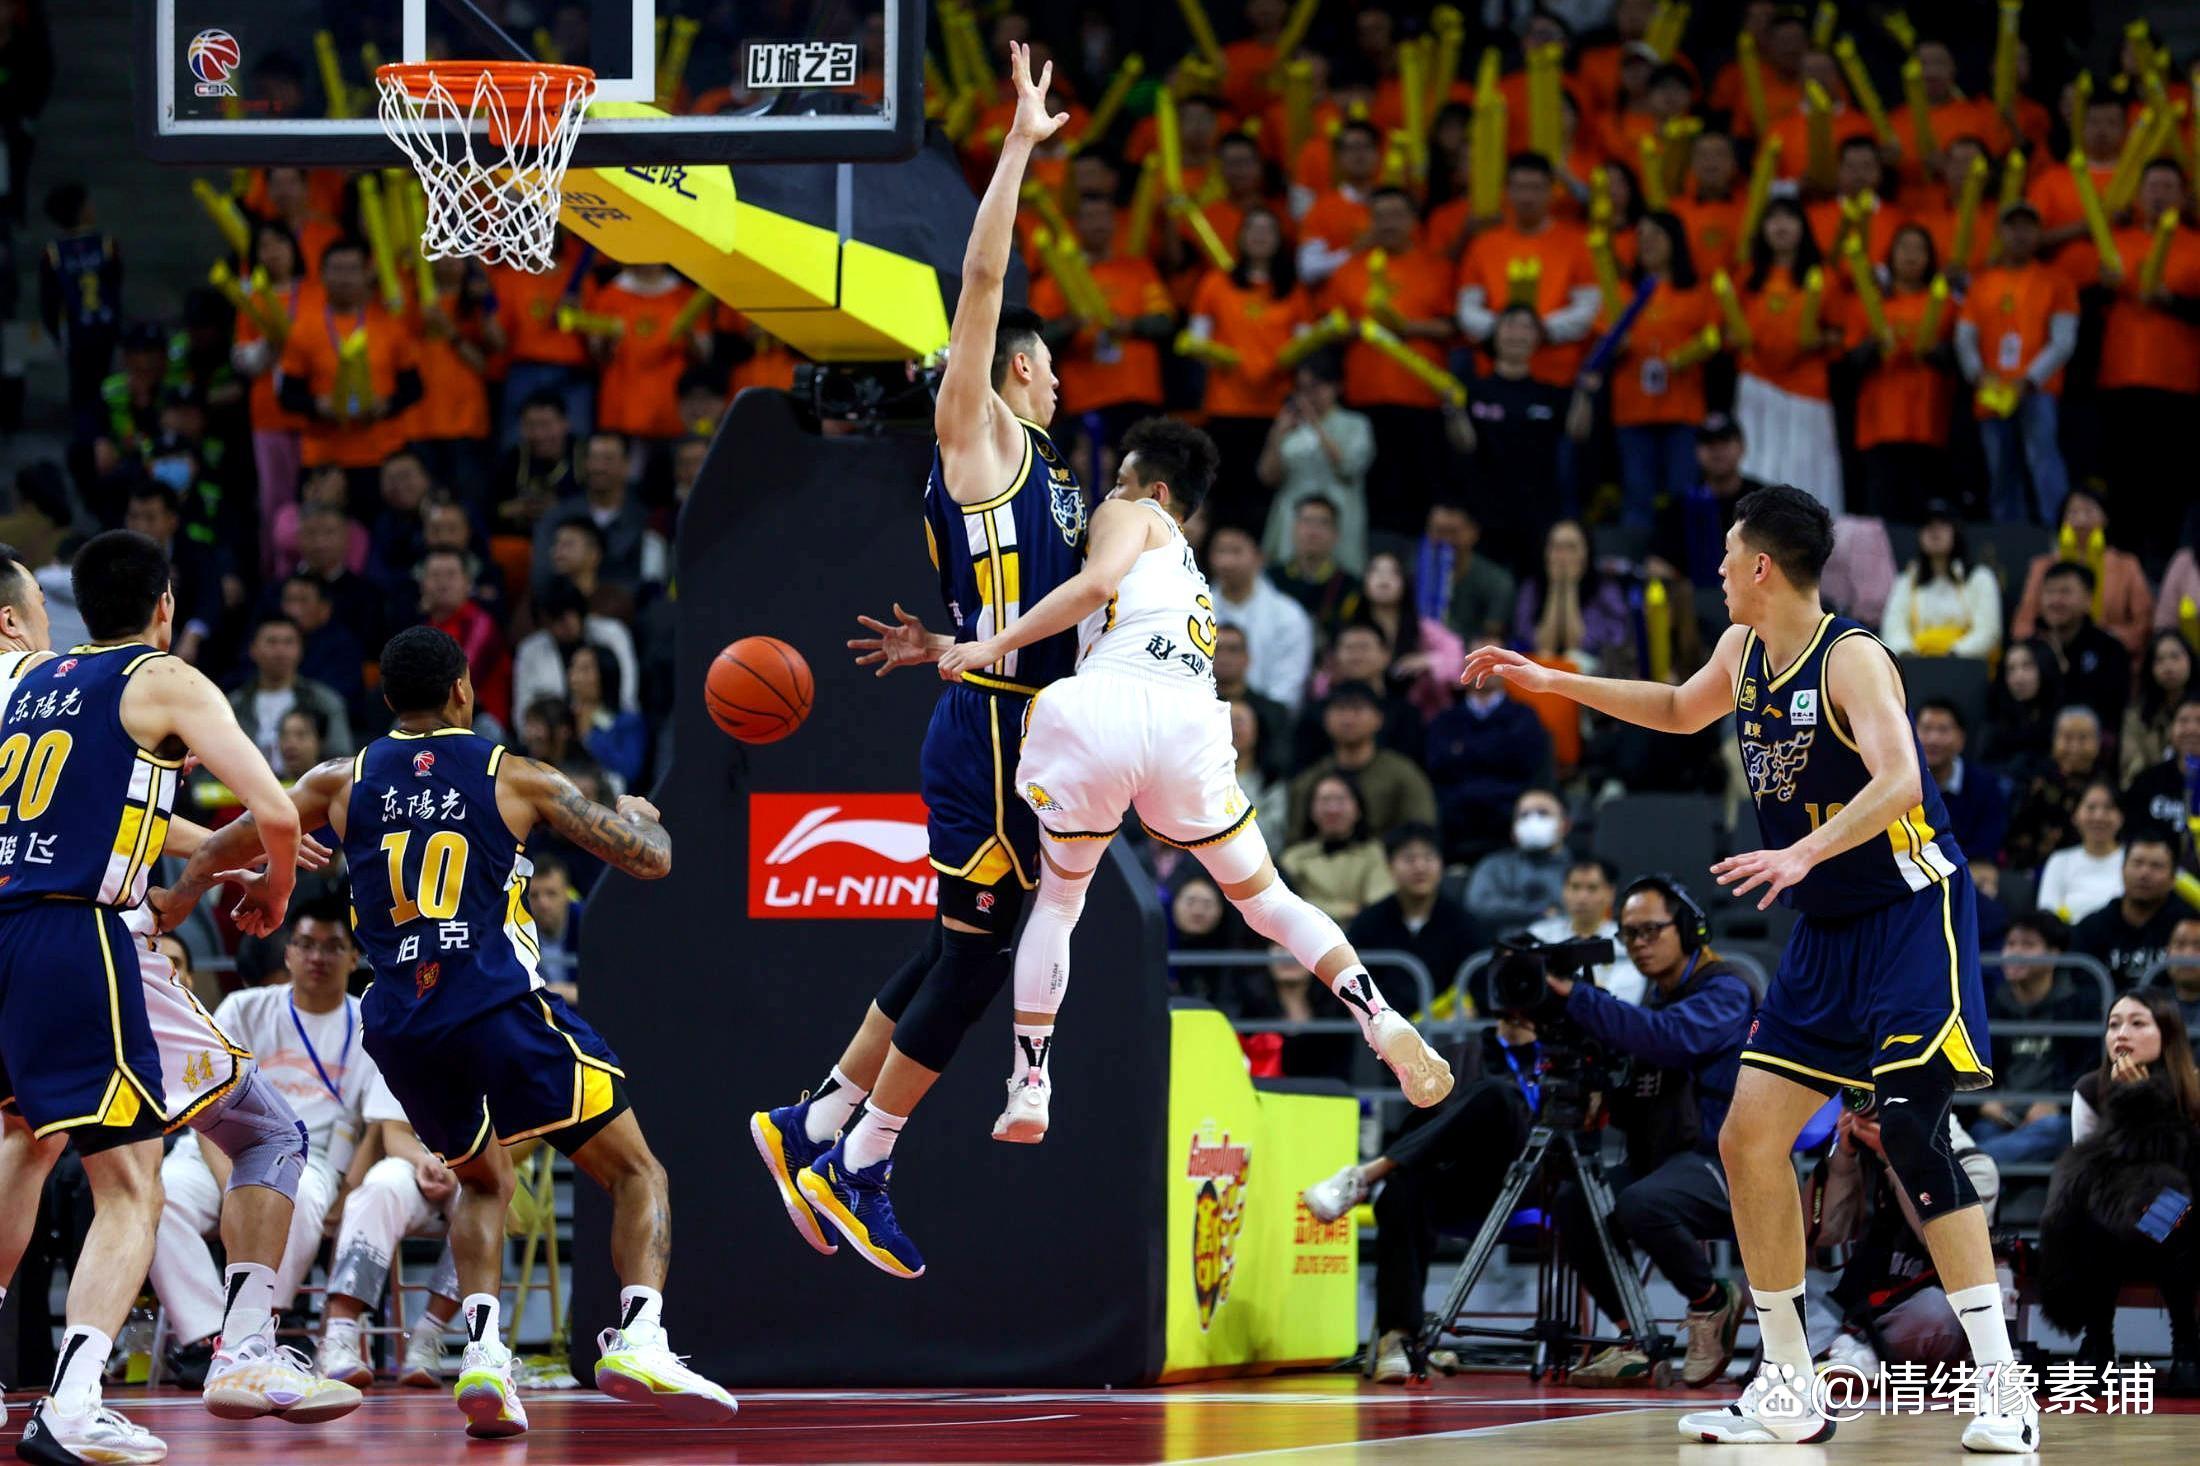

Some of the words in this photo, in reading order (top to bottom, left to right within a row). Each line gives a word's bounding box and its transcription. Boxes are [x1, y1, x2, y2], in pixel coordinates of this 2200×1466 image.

[750, 44, 855, 85] 以城之名
[195, 83, 237, 96] CBA
[0, 729, 74, 825] 20
[380, 830, 469, 927] 10
[396, 920, 470, 964] 伯克
